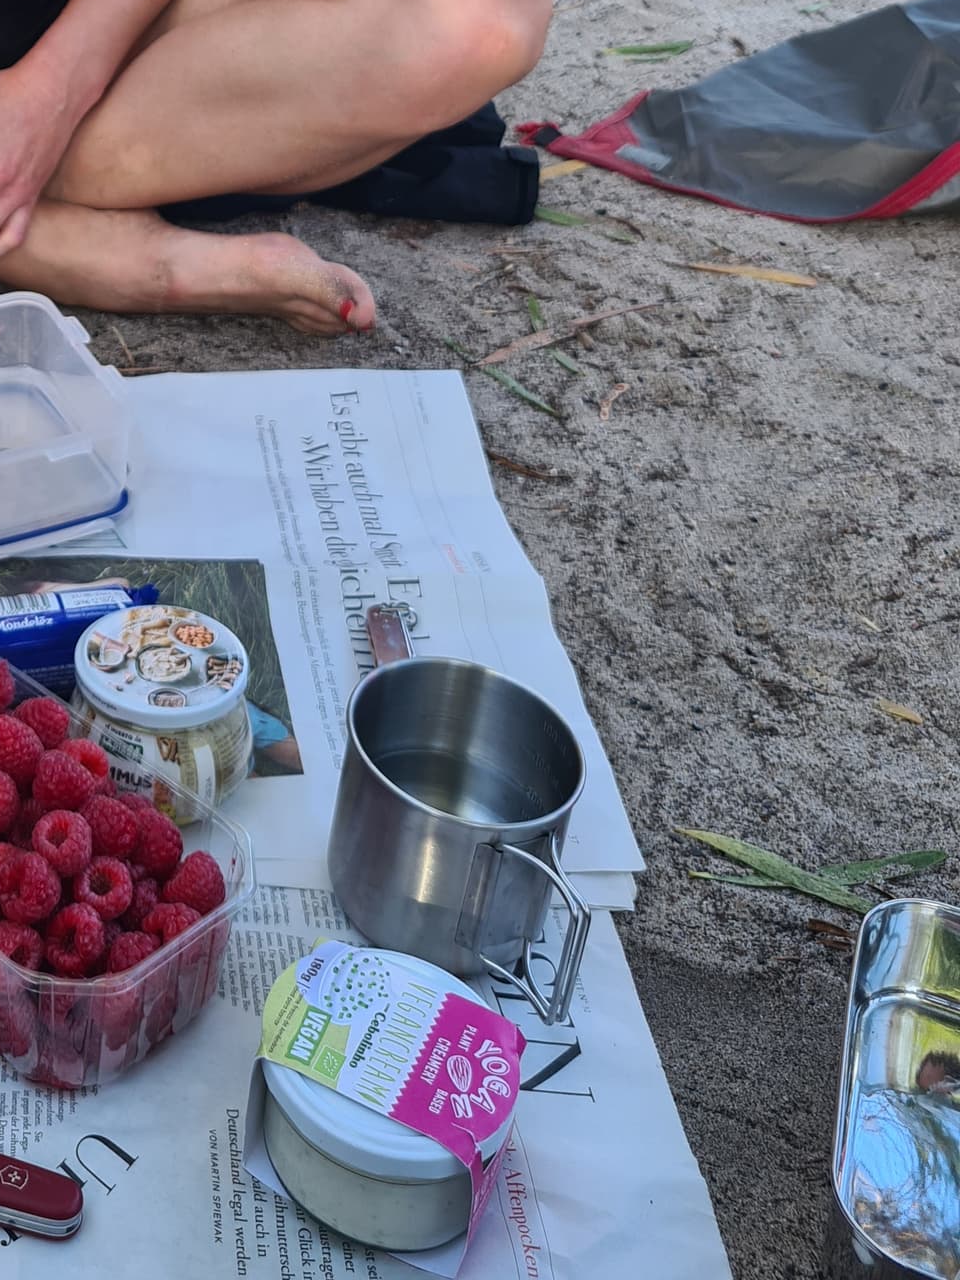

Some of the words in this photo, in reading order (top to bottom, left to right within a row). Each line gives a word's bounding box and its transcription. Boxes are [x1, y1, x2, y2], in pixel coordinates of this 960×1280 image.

[329, 390, 360, 415] Es
[328, 420, 368, 457] gibt
[345, 462, 384, 503] auch
[309, 483, 344, 531] haben
[358, 504, 398, 537] mal
[325, 536, 357, 558] die
[299, 955, 325, 984] 180g
[288, 1010, 328, 1062] VEGAN
[347, 1010, 387, 1070] Cebolinho
[457, 1024, 477, 1052] PLANT
[420, 1036, 450, 1085] CREAMERY
[428, 1088, 447, 1114] BASED
[209, 1129, 217, 1148] VON
[226, 1108, 242, 1185] Deutschland
[210, 1149, 221, 1193] MARTIN
[213, 1195, 223, 1244] SPIEWAK
[232, 1185, 245, 1221] legal
[254, 1204, 265, 1240] auch
[503, 1167, 539, 1280] Affenpocken
[235, 1224, 247, 1276] werden
[258, 1244, 267, 1257] in
[297, 1227, 311, 1268] Glück
